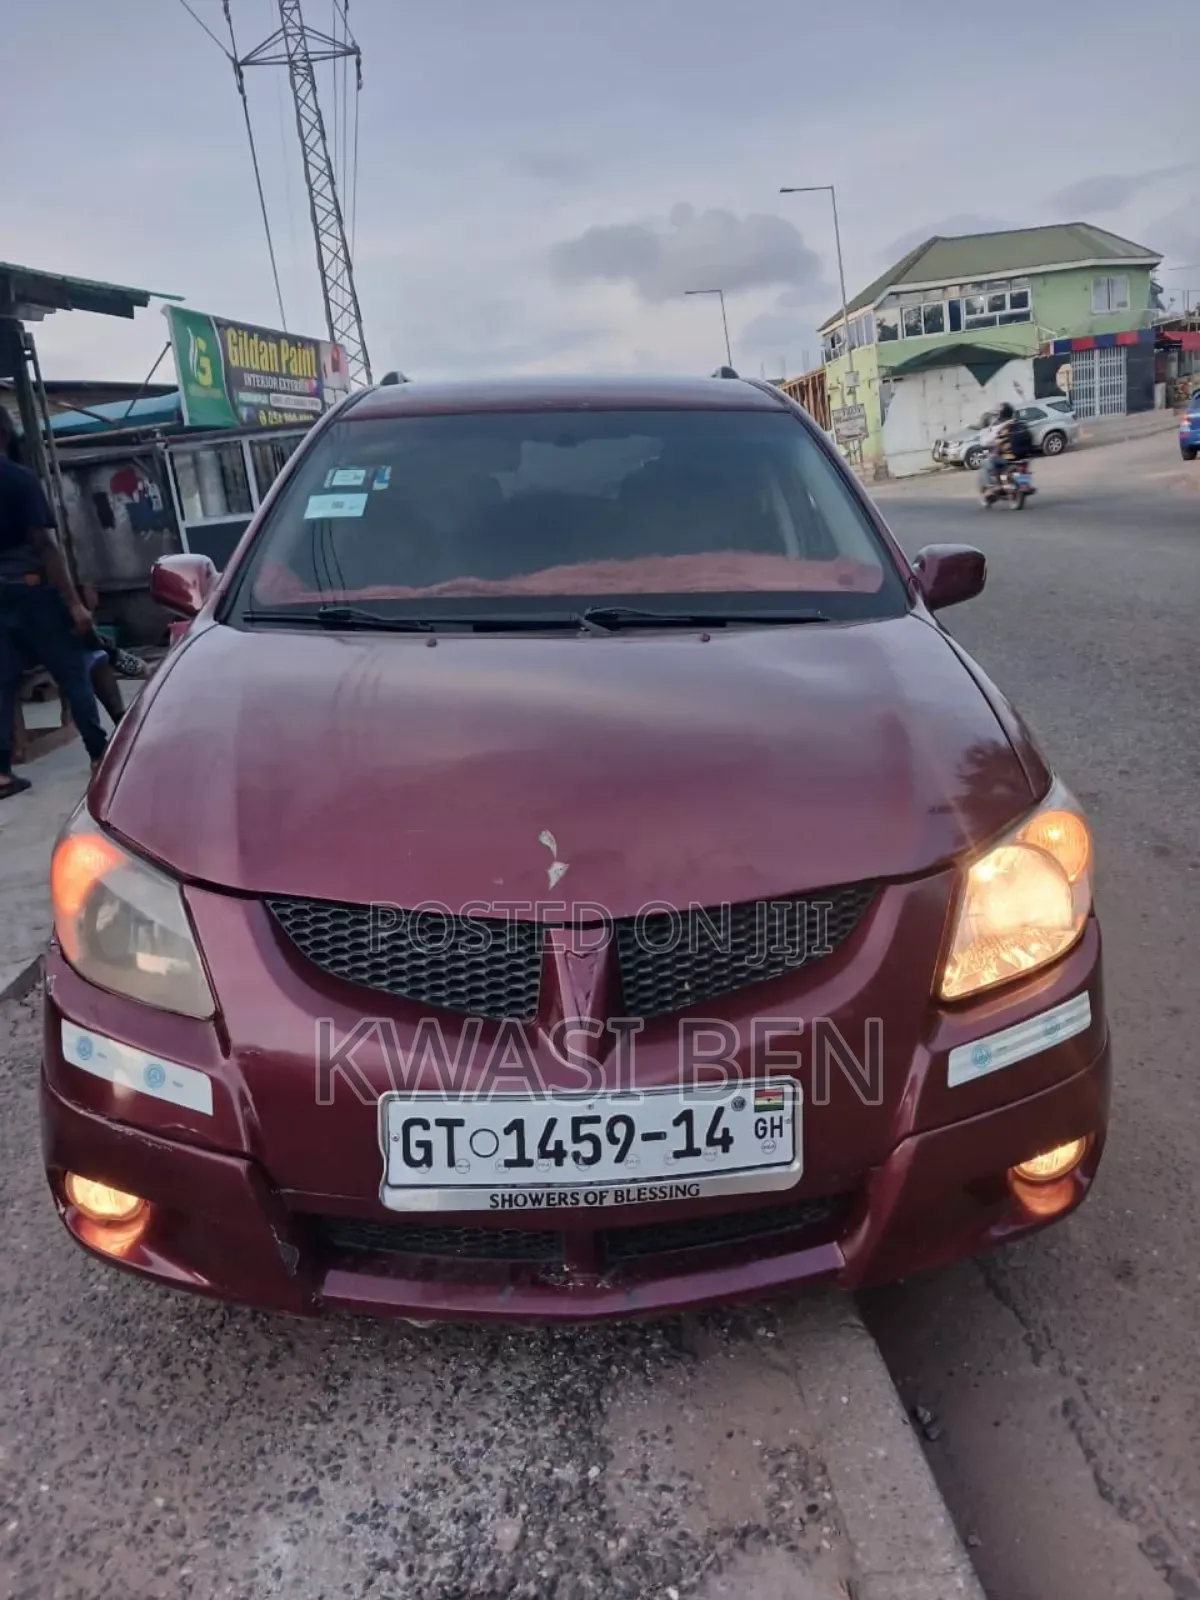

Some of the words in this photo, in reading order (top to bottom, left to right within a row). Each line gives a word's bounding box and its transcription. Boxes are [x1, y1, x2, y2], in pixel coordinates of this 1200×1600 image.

[226, 326, 280, 373] Gildan
[280, 339, 318, 378] Paint
[243, 371, 277, 391] INTERIOR
[754, 1115, 784, 1140] GH
[489, 1190, 581, 1209] SHOWERS
[583, 1189, 609, 1206] OF
[613, 1183, 700, 1204] BLESSING
